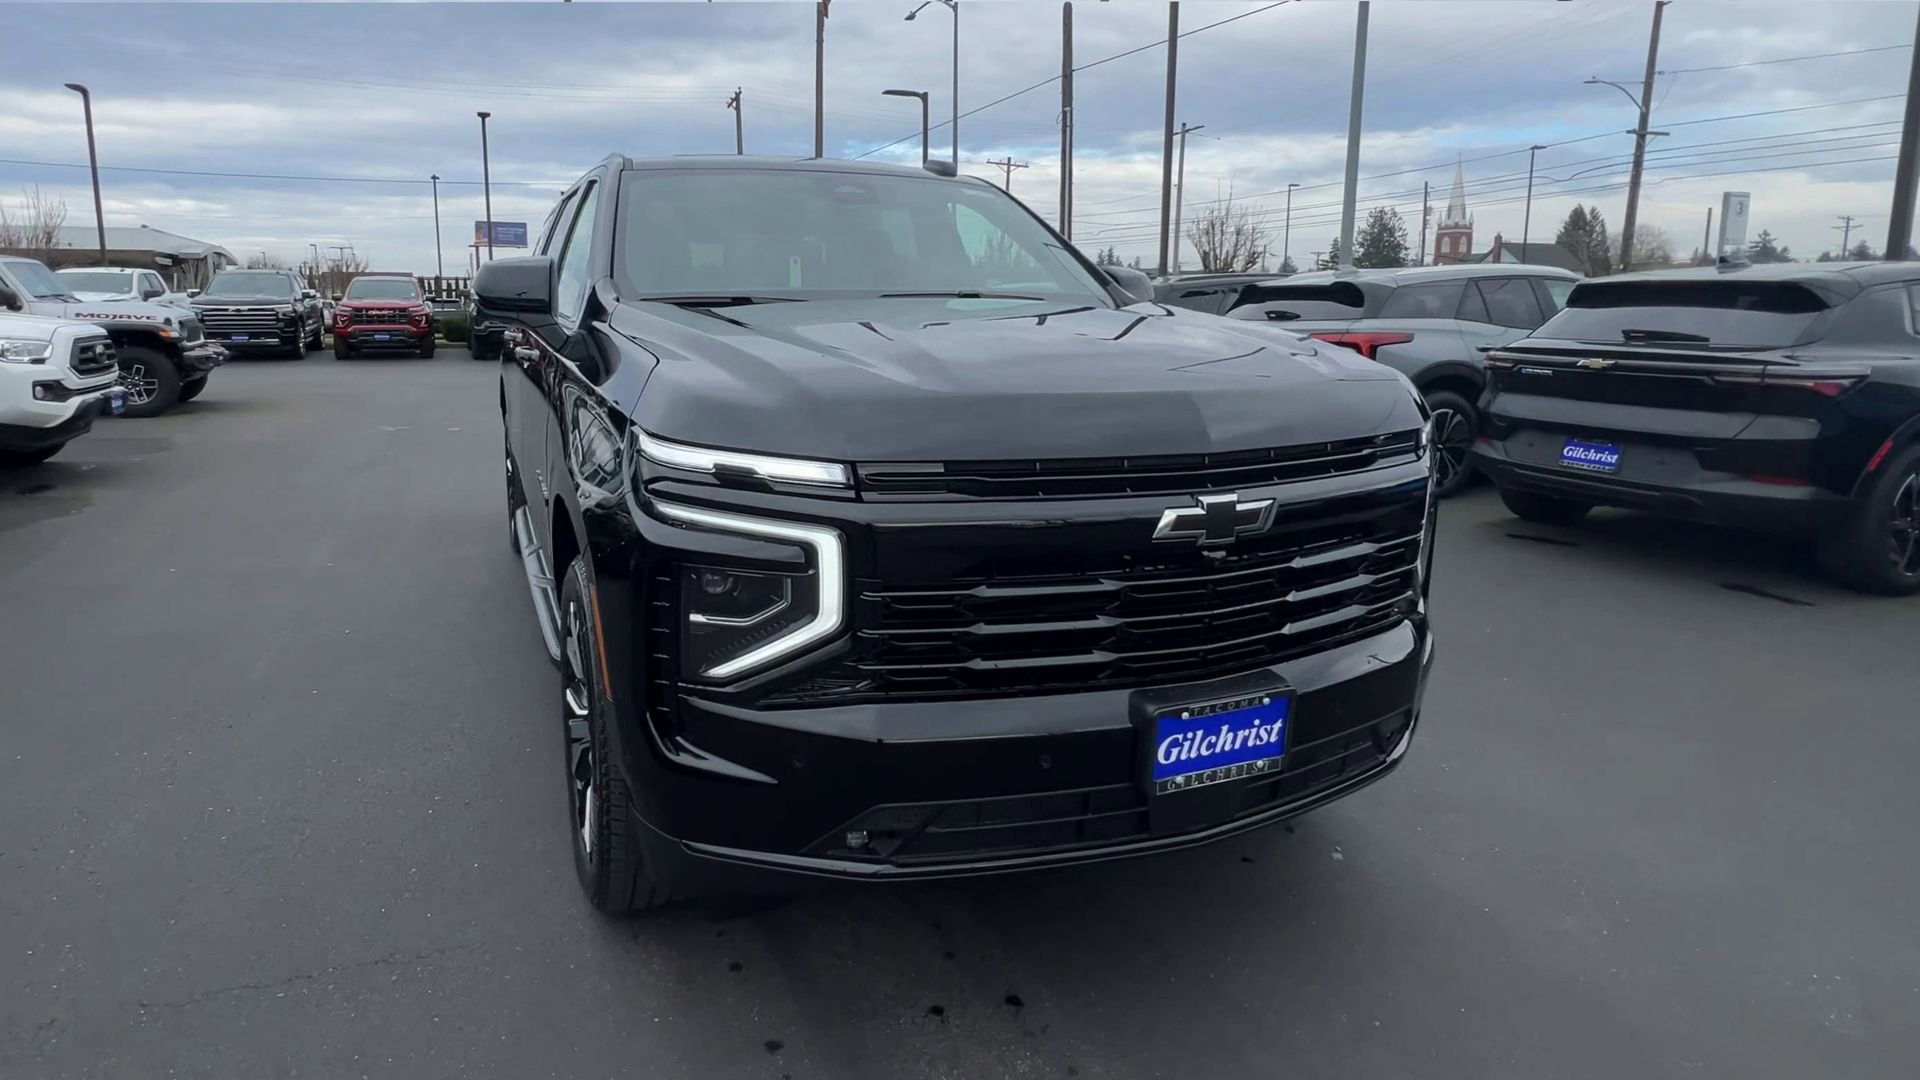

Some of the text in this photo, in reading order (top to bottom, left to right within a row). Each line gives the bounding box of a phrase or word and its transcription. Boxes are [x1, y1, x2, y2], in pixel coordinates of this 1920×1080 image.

[1736, 201, 1744, 217] 3
[74, 312, 158, 320] MOJAVE
[1563, 446, 1619, 463] Gilchrist
[1193, 698, 1260, 717] TACOMA
[1157, 718, 1283, 765] Gilchrist
